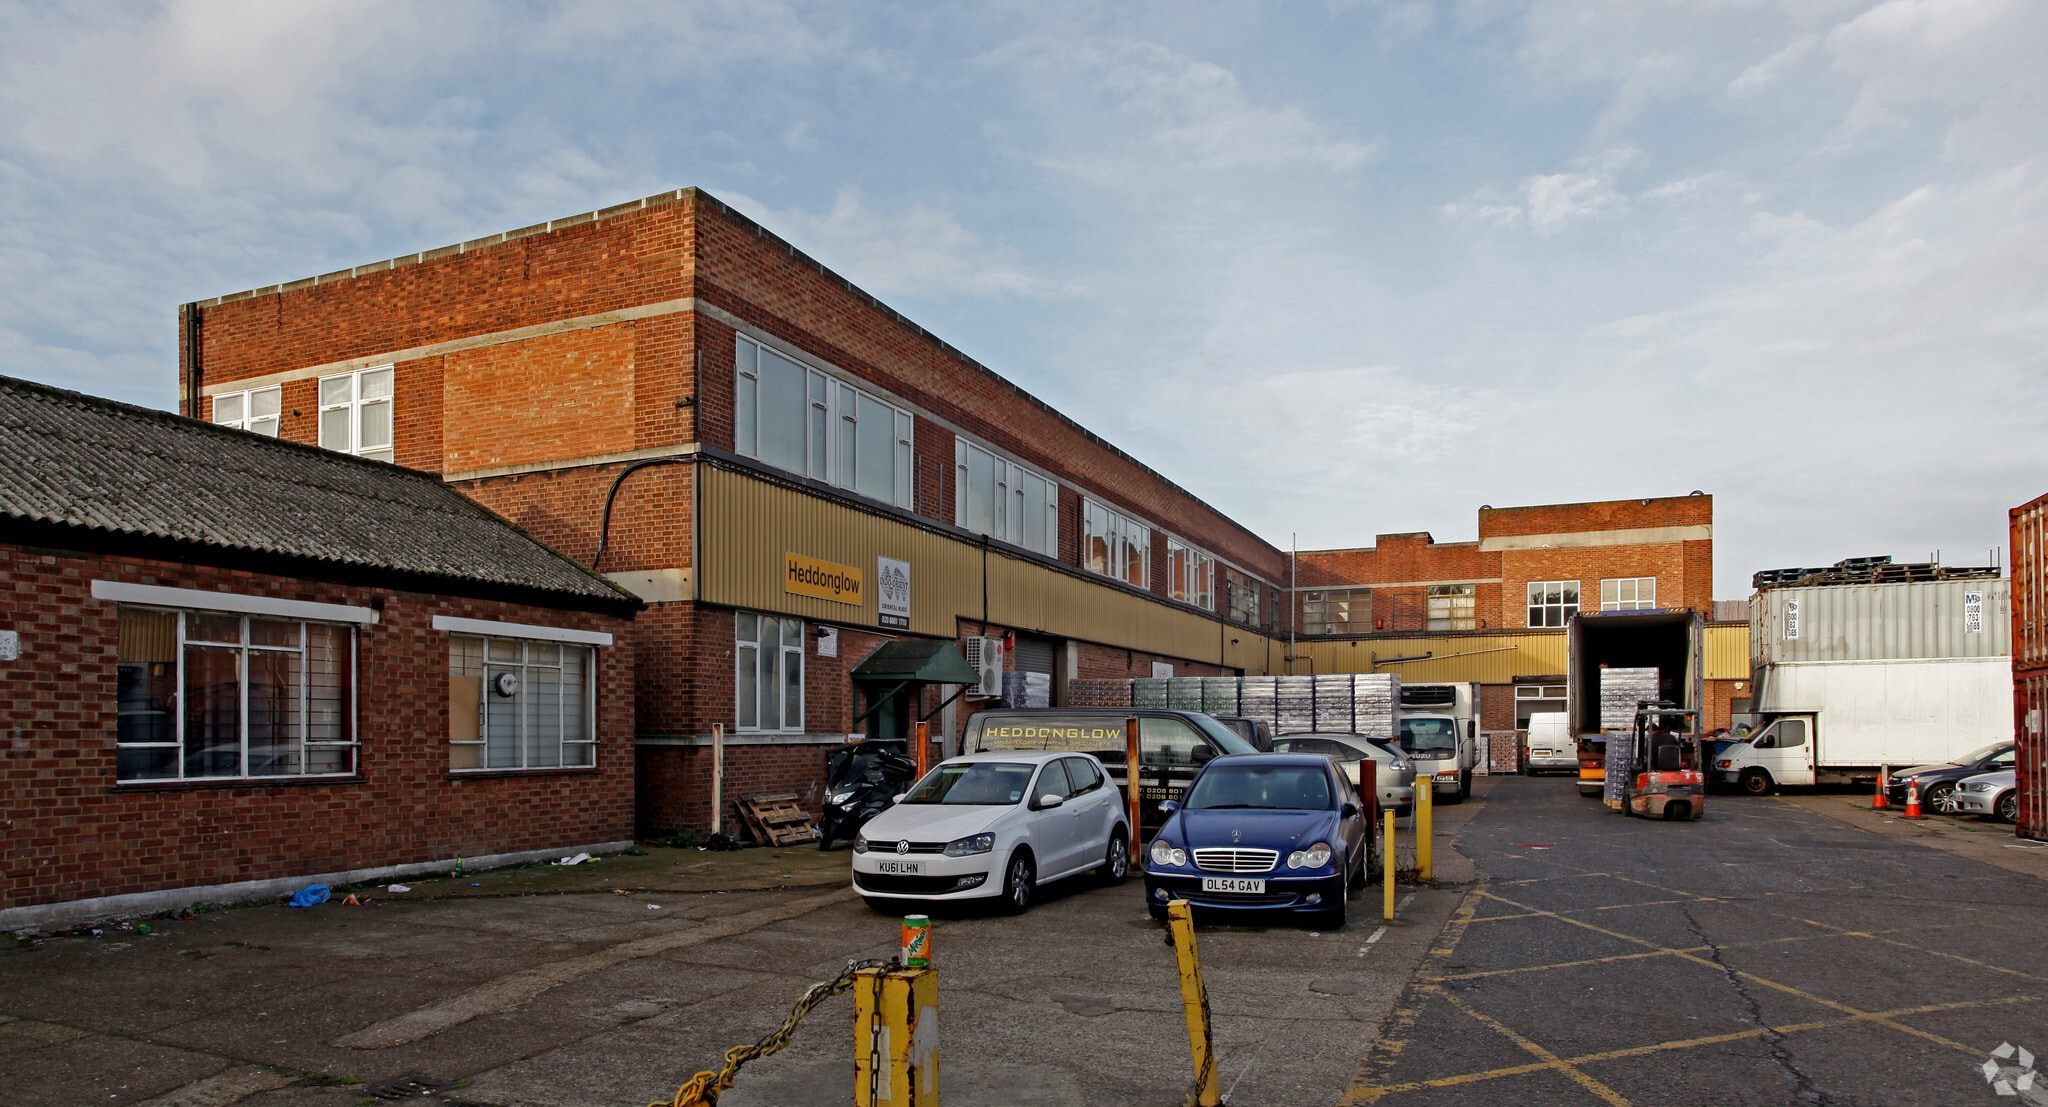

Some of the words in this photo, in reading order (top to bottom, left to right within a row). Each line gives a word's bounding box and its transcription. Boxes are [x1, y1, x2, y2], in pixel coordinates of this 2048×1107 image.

[789, 560, 860, 595] Heddonglow
[881, 602, 898, 612] ORIENTAL
[1967, 605, 1980, 613] 0800
[986, 727, 1120, 739] HEDDONGLOW
[879, 862, 899, 873] KU61
[900, 863, 918, 873] LHN
[1207, 879, 1235, 890] OL54
[1238, 880, 1260, 891] GAV
